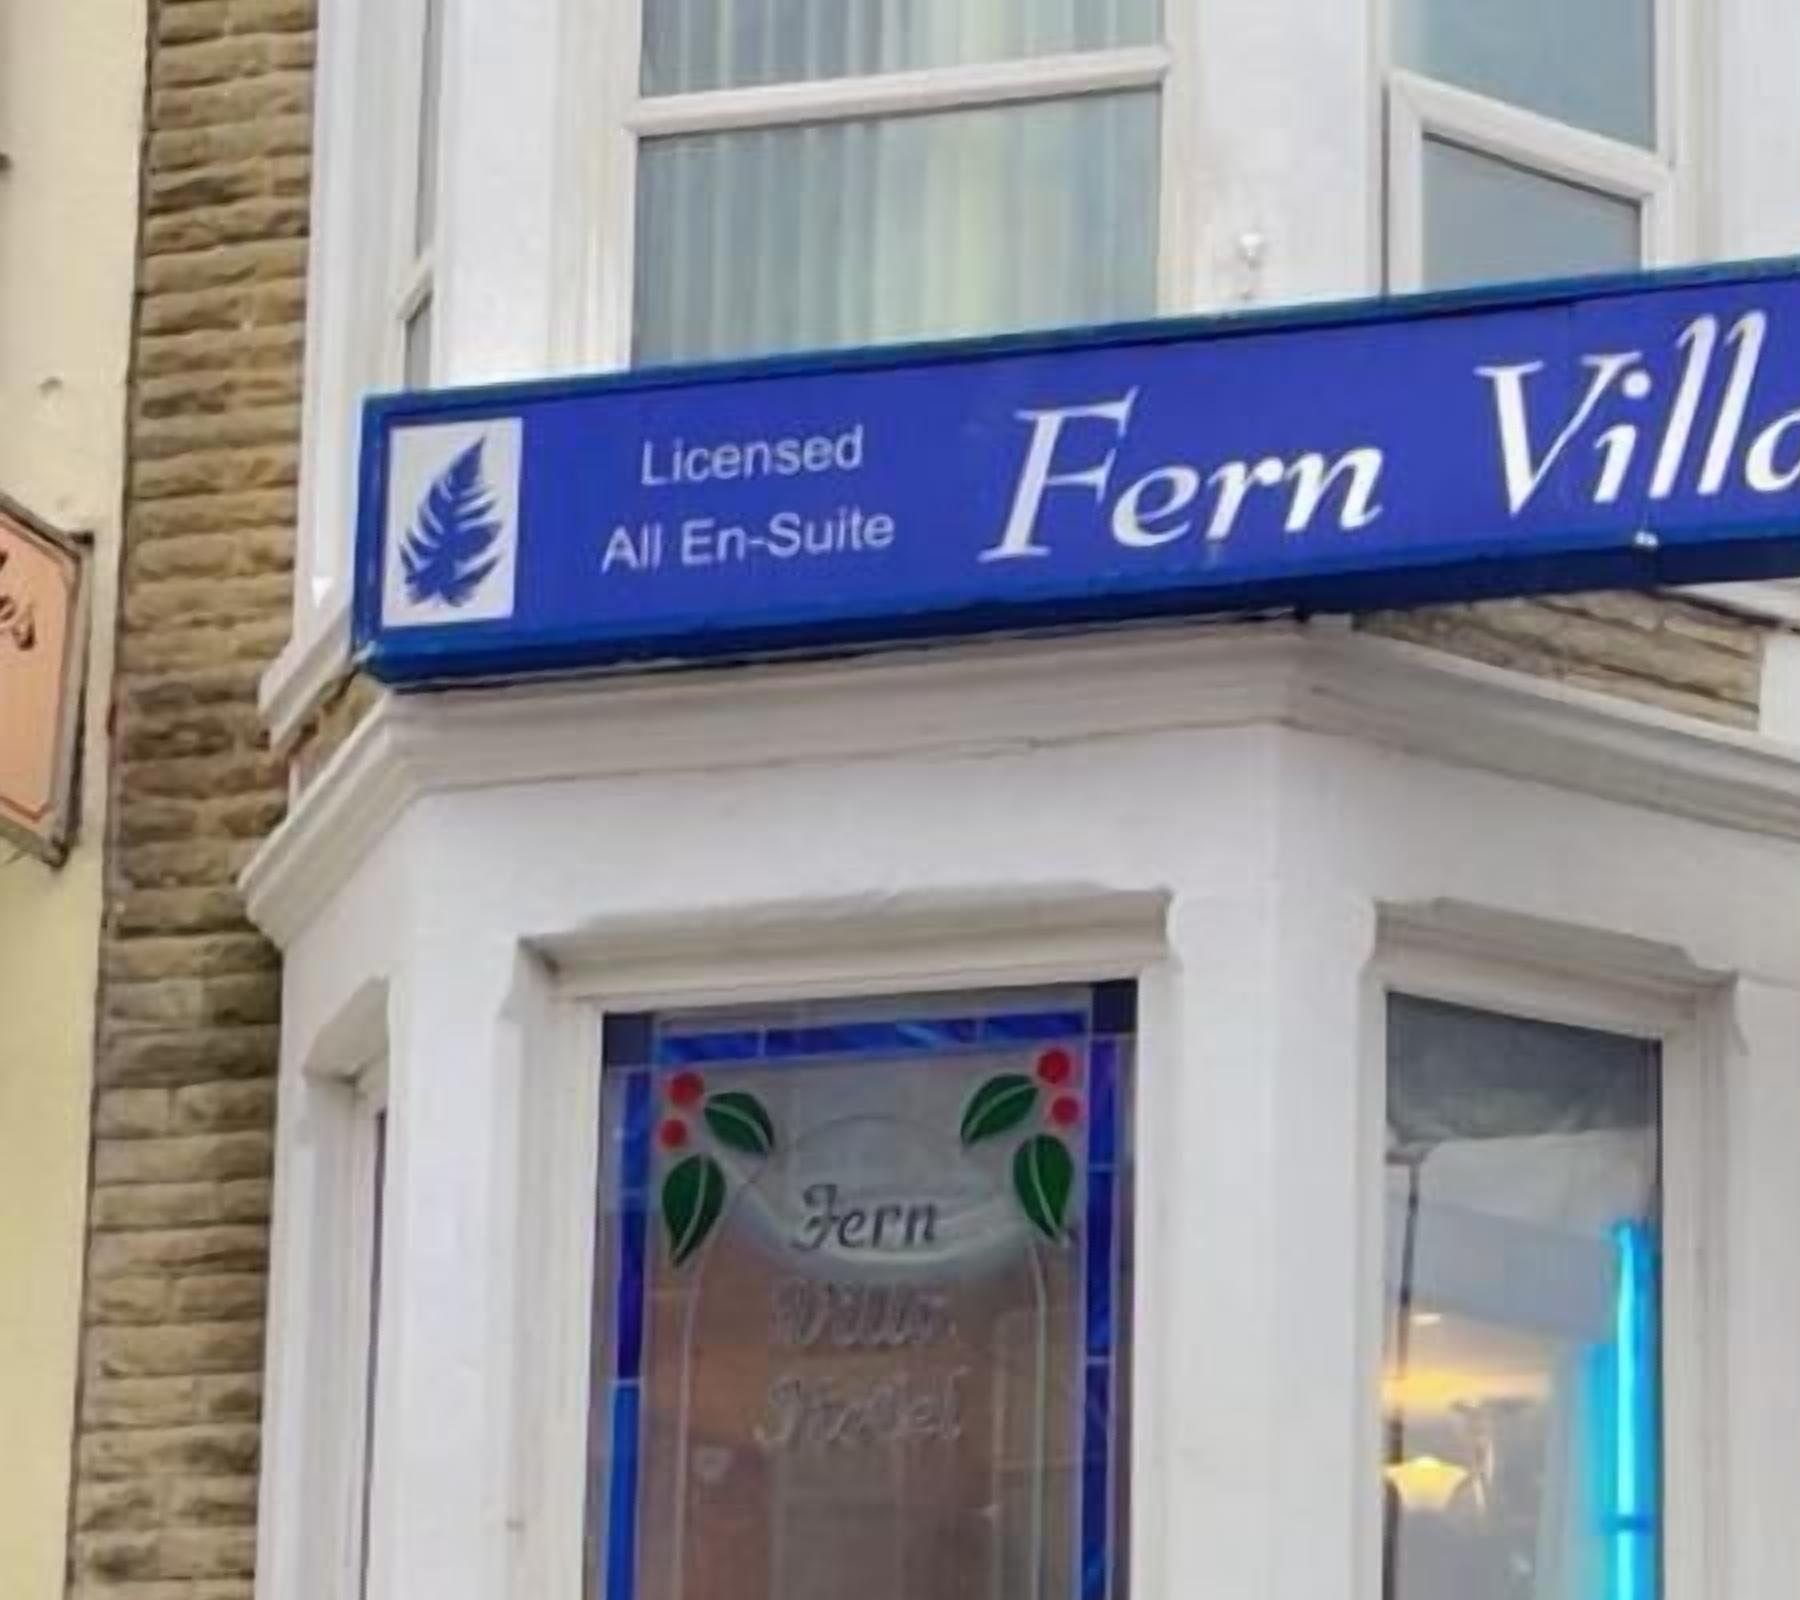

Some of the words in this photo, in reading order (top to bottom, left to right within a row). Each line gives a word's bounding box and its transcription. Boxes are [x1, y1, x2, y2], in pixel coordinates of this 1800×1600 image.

[641, 425, 864, 487] Licensed
[978, 386, 1384, 563] Fern
[602, 524, 661, 573] All
[680, 508, 895, 565] En-Suite
[790, 1183, 939, 1251] Fern
